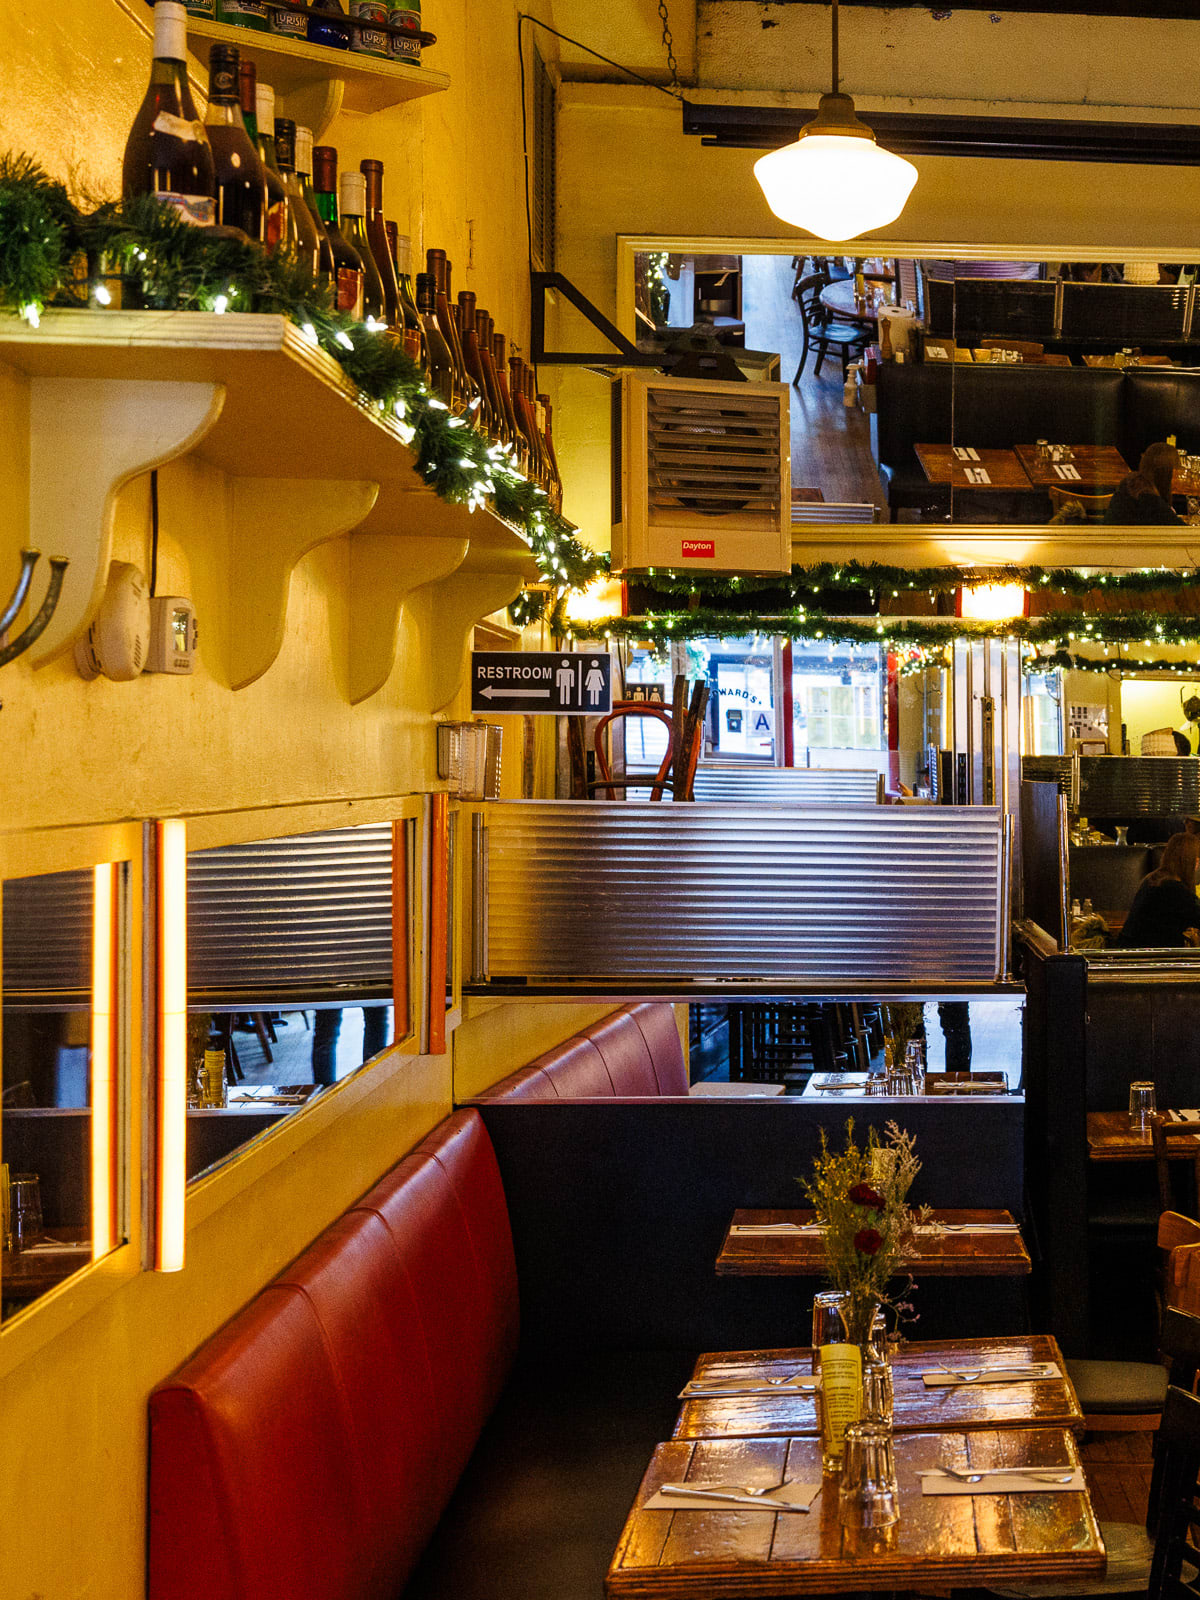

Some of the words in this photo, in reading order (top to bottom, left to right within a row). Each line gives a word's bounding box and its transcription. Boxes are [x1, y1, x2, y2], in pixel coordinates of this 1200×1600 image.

[682, 541, 712, 551] Dayton
[477, 666, 552, 679] RESTROOM
[755, 713, 770, 731] A
